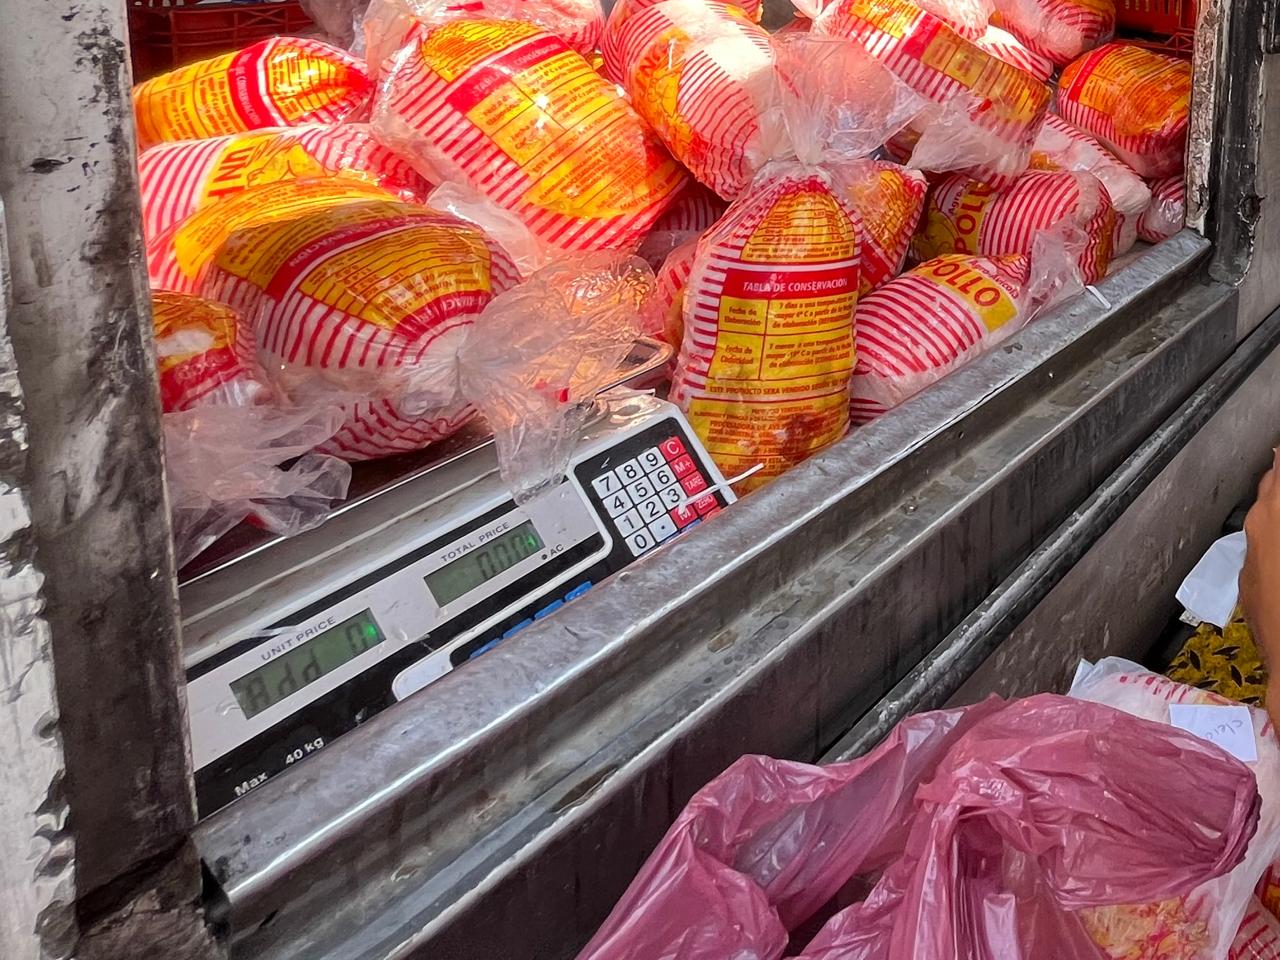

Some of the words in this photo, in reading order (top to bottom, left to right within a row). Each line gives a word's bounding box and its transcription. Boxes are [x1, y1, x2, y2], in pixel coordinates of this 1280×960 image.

[953, 184, 991, 255] POLL
[743, 281, 771, 291] TABLA
[773, 282, 785, 292] DE
[917, 259, 1001, 307] POLLO
[599, 476, 611, 492] 7
[624, 464, 637, 479] 8
[645, 452, 659, 467] 9
[666, 441, 680, 455] C
[614, 495, 625, 510] 4
[634, 482, 648, 498] 5
[657, 470, 670, 485] 6
[674, 460, 692, 474] M+
[623, 515, 635, 529] 1
[645, 501, 659, 518] 2
[667, 488, 680, 503] 3
[684, 475, 703, 490] TARE
[440, 542, 476, 563] TOTAL
[478, 522, 510, 543] PRICE
[549, 544, 564, 557] AC
[634, 534, 648, 549] 0
[261, 639, 294, 661] UNIT
[296, 616, 337, 641] PRICE
[234, 771, 268, 797] Max
[285, 749, 304, 766] 40
[305, 737, 325, 754] kg
